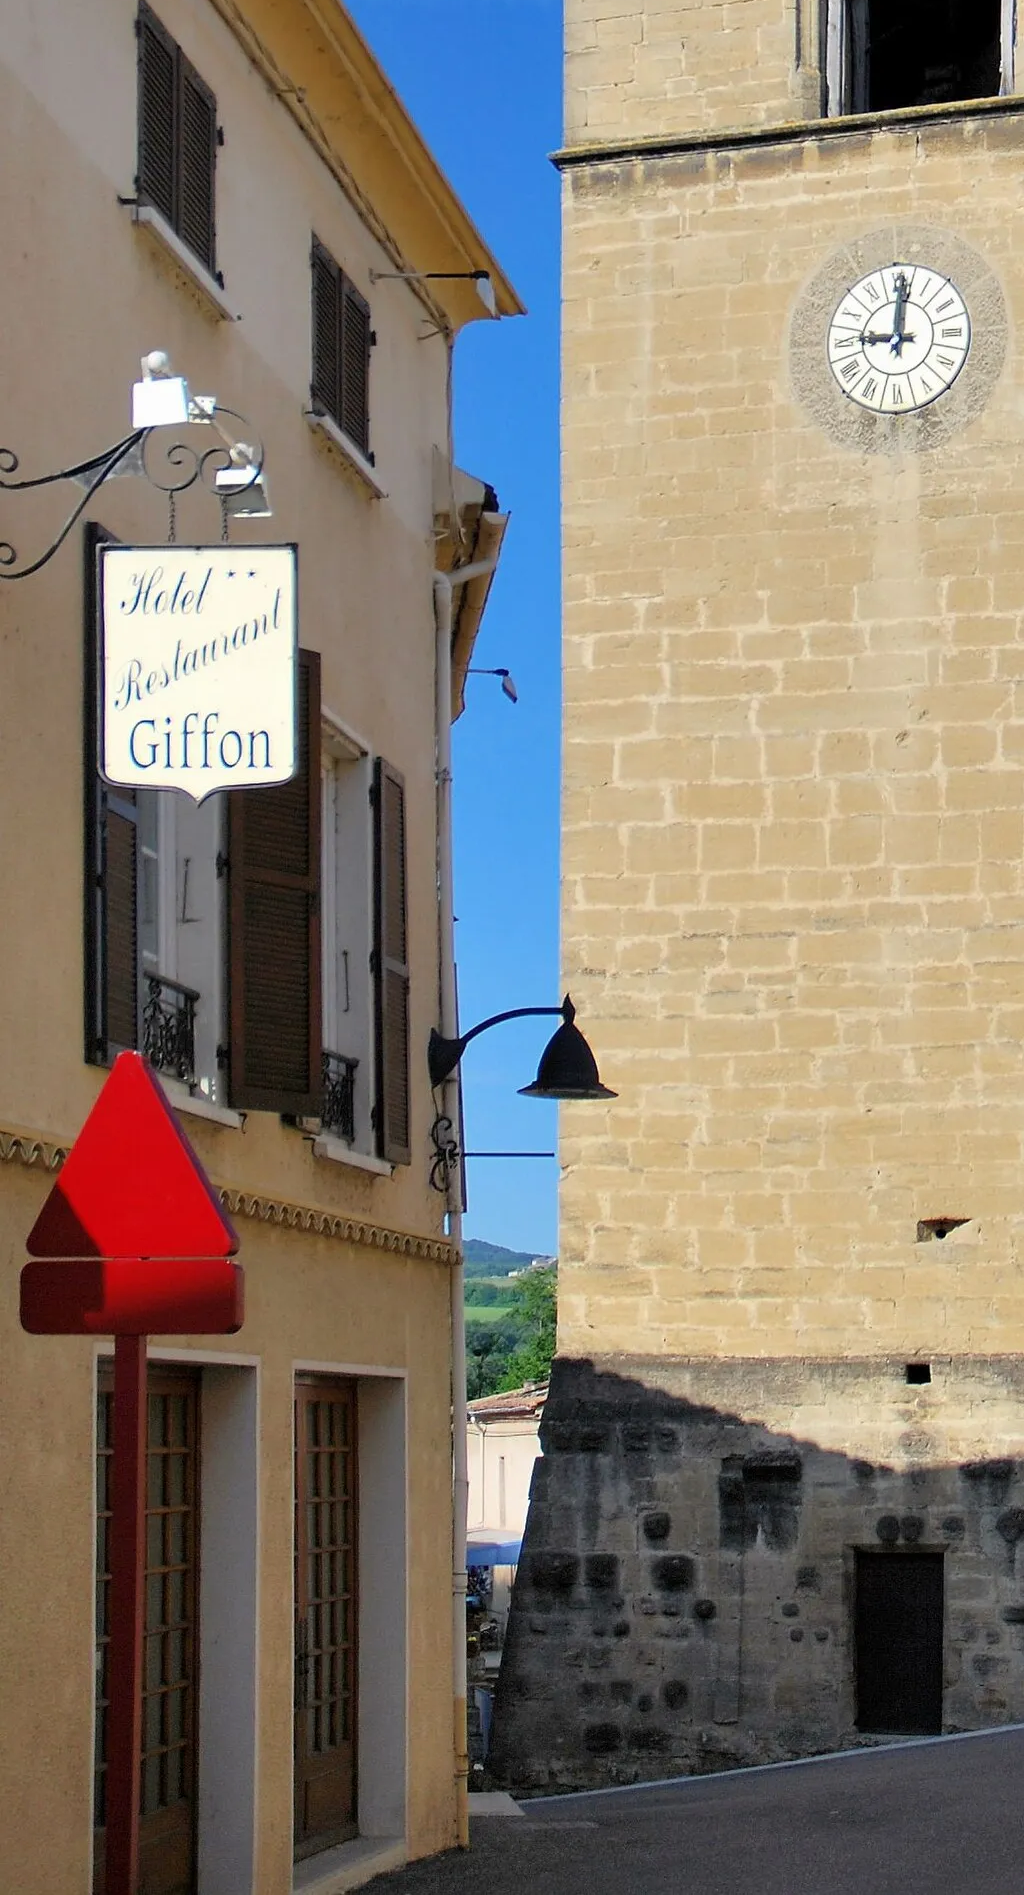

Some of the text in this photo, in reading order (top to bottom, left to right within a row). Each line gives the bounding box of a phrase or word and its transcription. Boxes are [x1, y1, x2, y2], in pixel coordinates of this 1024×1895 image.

[941, 327, 963, 338] III
[120, 566, 213, 616] Hotel
[113, 586, 281, 711] Restaurant
[129, 711, 274, 770] Giffon
